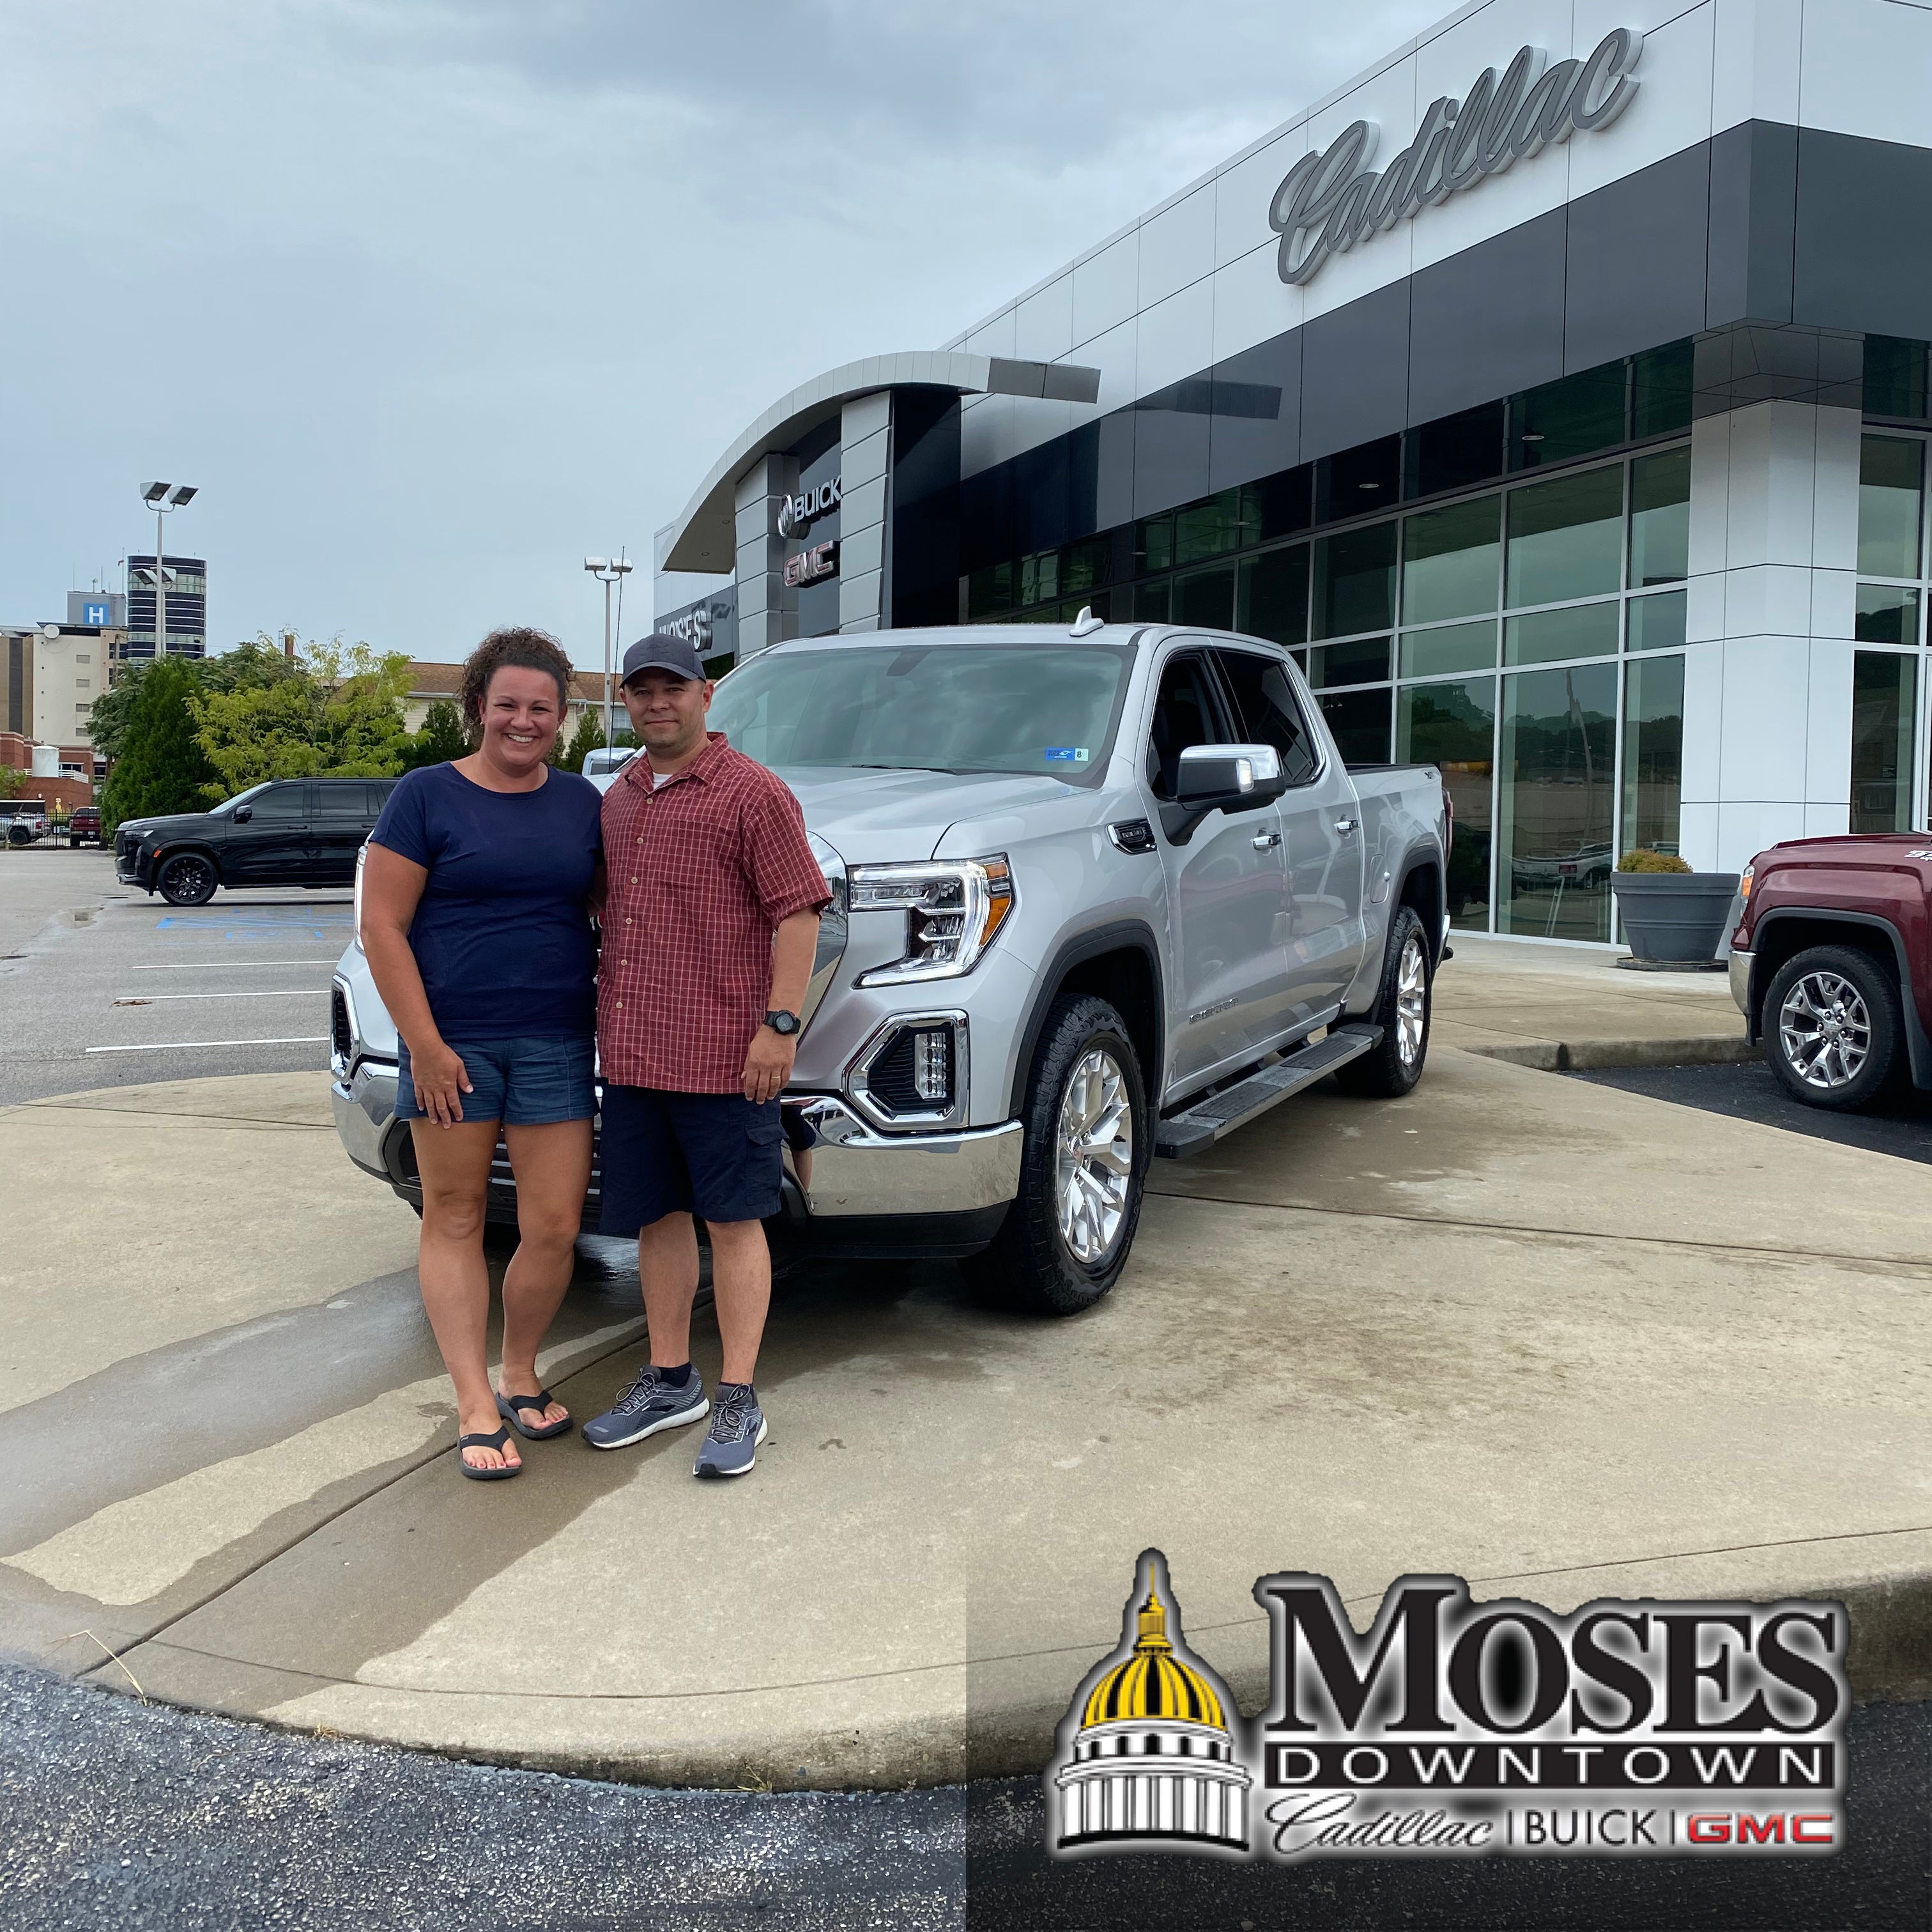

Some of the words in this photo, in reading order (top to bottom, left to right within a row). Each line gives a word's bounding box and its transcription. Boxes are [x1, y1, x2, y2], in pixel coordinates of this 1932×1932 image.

[1269, 27, 1642, 286] Cadillac
[794, 475, 843, 523] BUICK
[784, 540, 834, 587] GMC
[89, 606, 103, 624] H
[659, 610, 705, 650] SES
